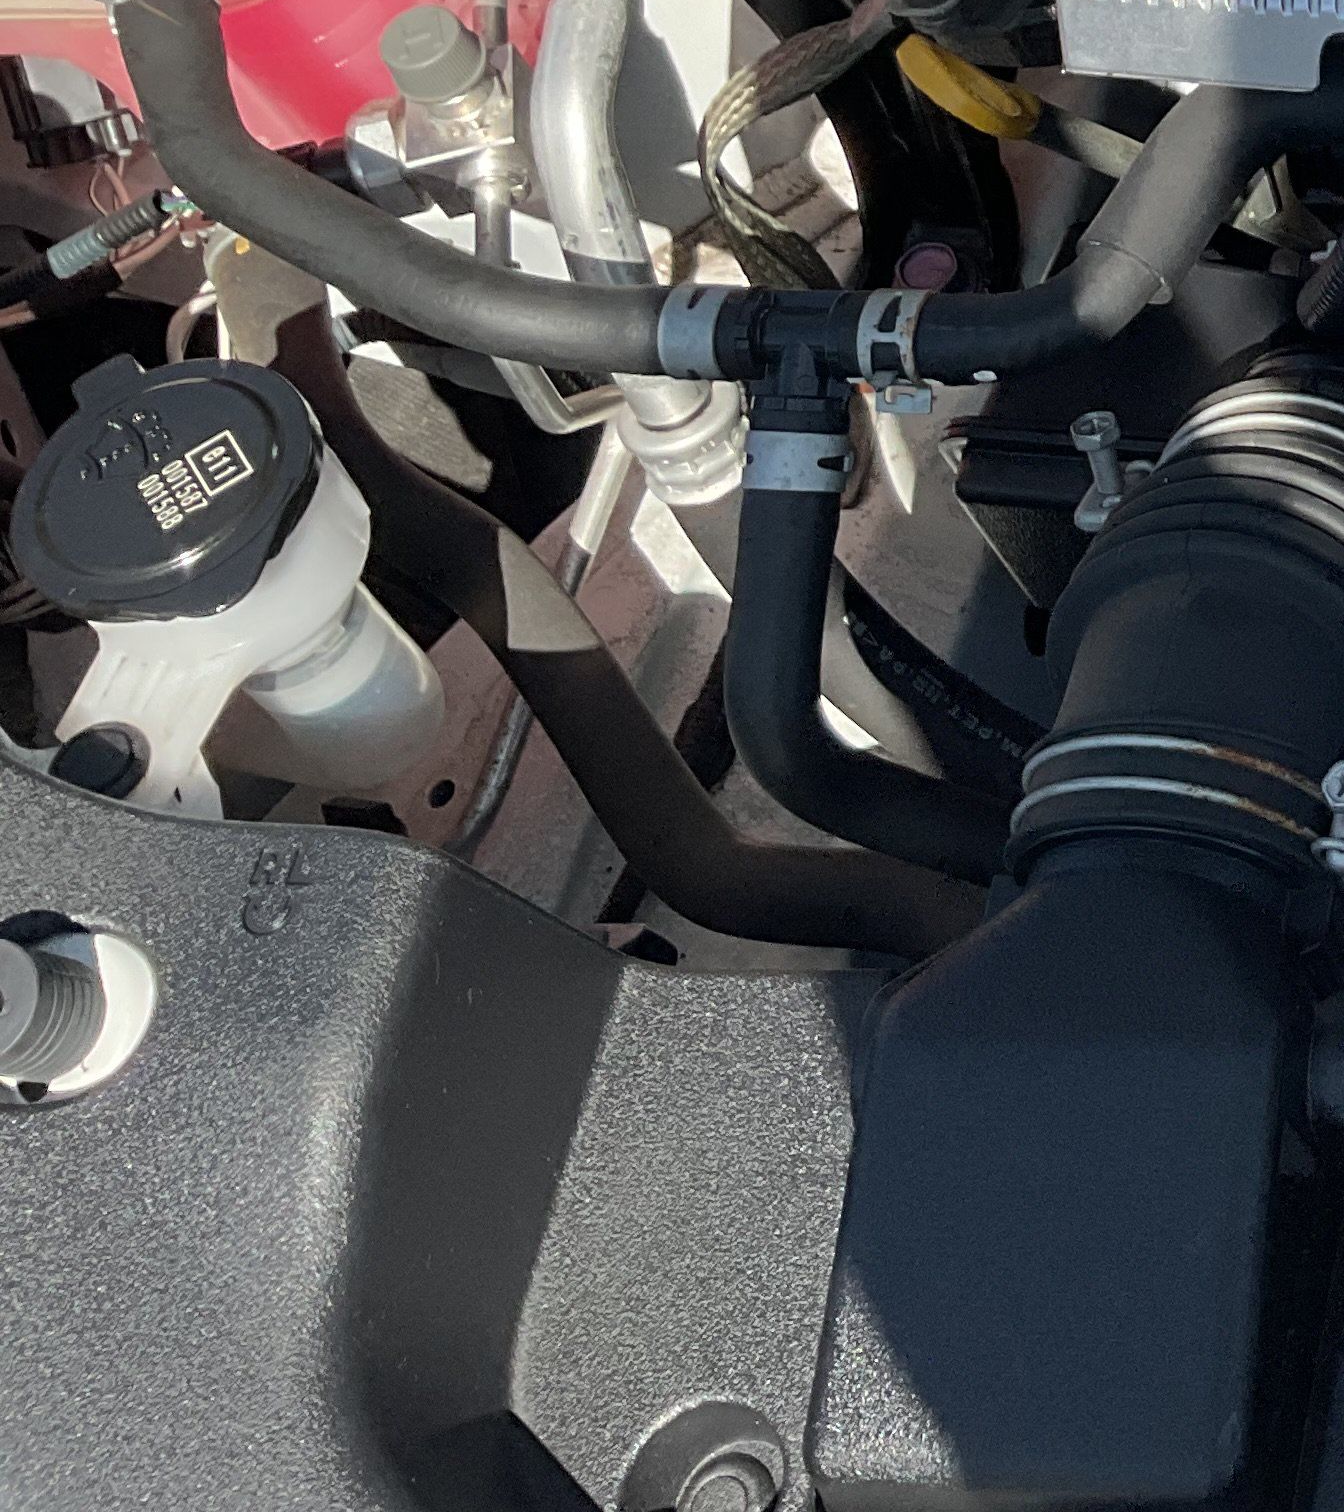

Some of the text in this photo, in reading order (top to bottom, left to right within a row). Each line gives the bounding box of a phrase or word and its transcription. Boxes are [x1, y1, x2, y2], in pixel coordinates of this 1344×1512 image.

[162, 459, 209, 513] 001587
[203, 445, 239, 481] e11
[138, 473, 184, 530] 001588
